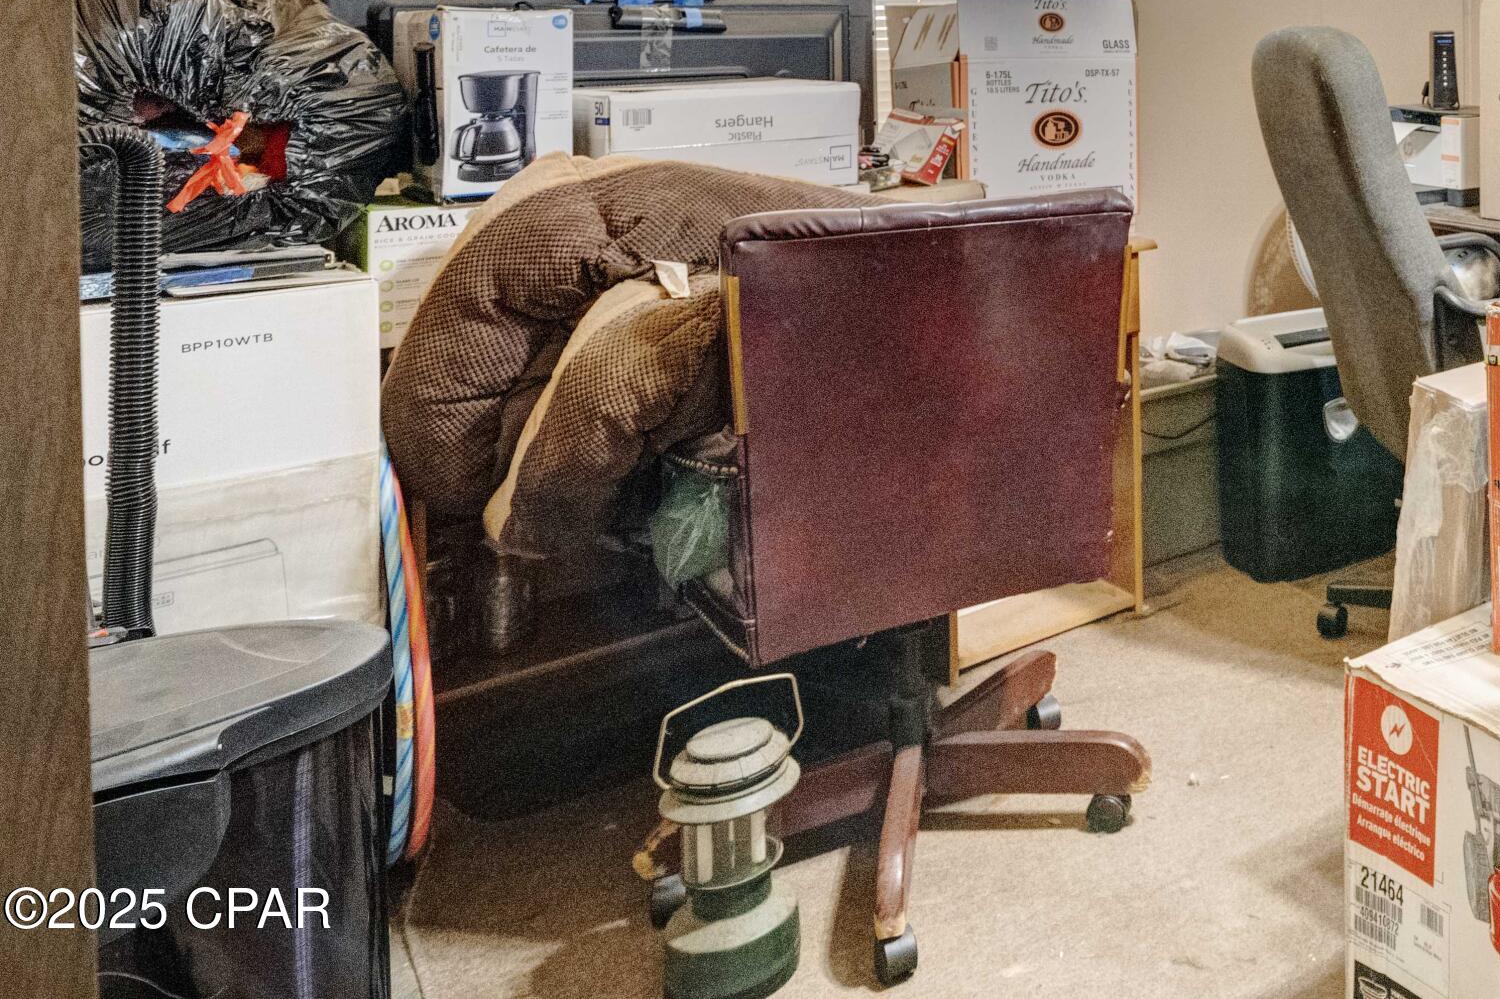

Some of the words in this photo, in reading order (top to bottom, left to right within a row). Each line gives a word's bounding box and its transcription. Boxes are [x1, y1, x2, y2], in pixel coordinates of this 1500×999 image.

[484, 45, 523, 54] Cafetera
[525, 46, 537, 54] de
[1102, 40, 1130, 49] GLASS
[714, 113, 773, 128] Hangers
[728, 131, 762, 142] Plastic
[1018, 151, 1096, 173] Handmade
[1040, 173, 1076, 182] VODKA
[375, 213, 457, 233] AROMA
[181, 333, 273, 353] BPP10WTB
[1357, 745, 1431, 801] ELECTRIC
[1356, 765, 1431, 825] START
[1357, 814, 1391, 841] Arranque
[1361, 866, 1404, 906] 21464
